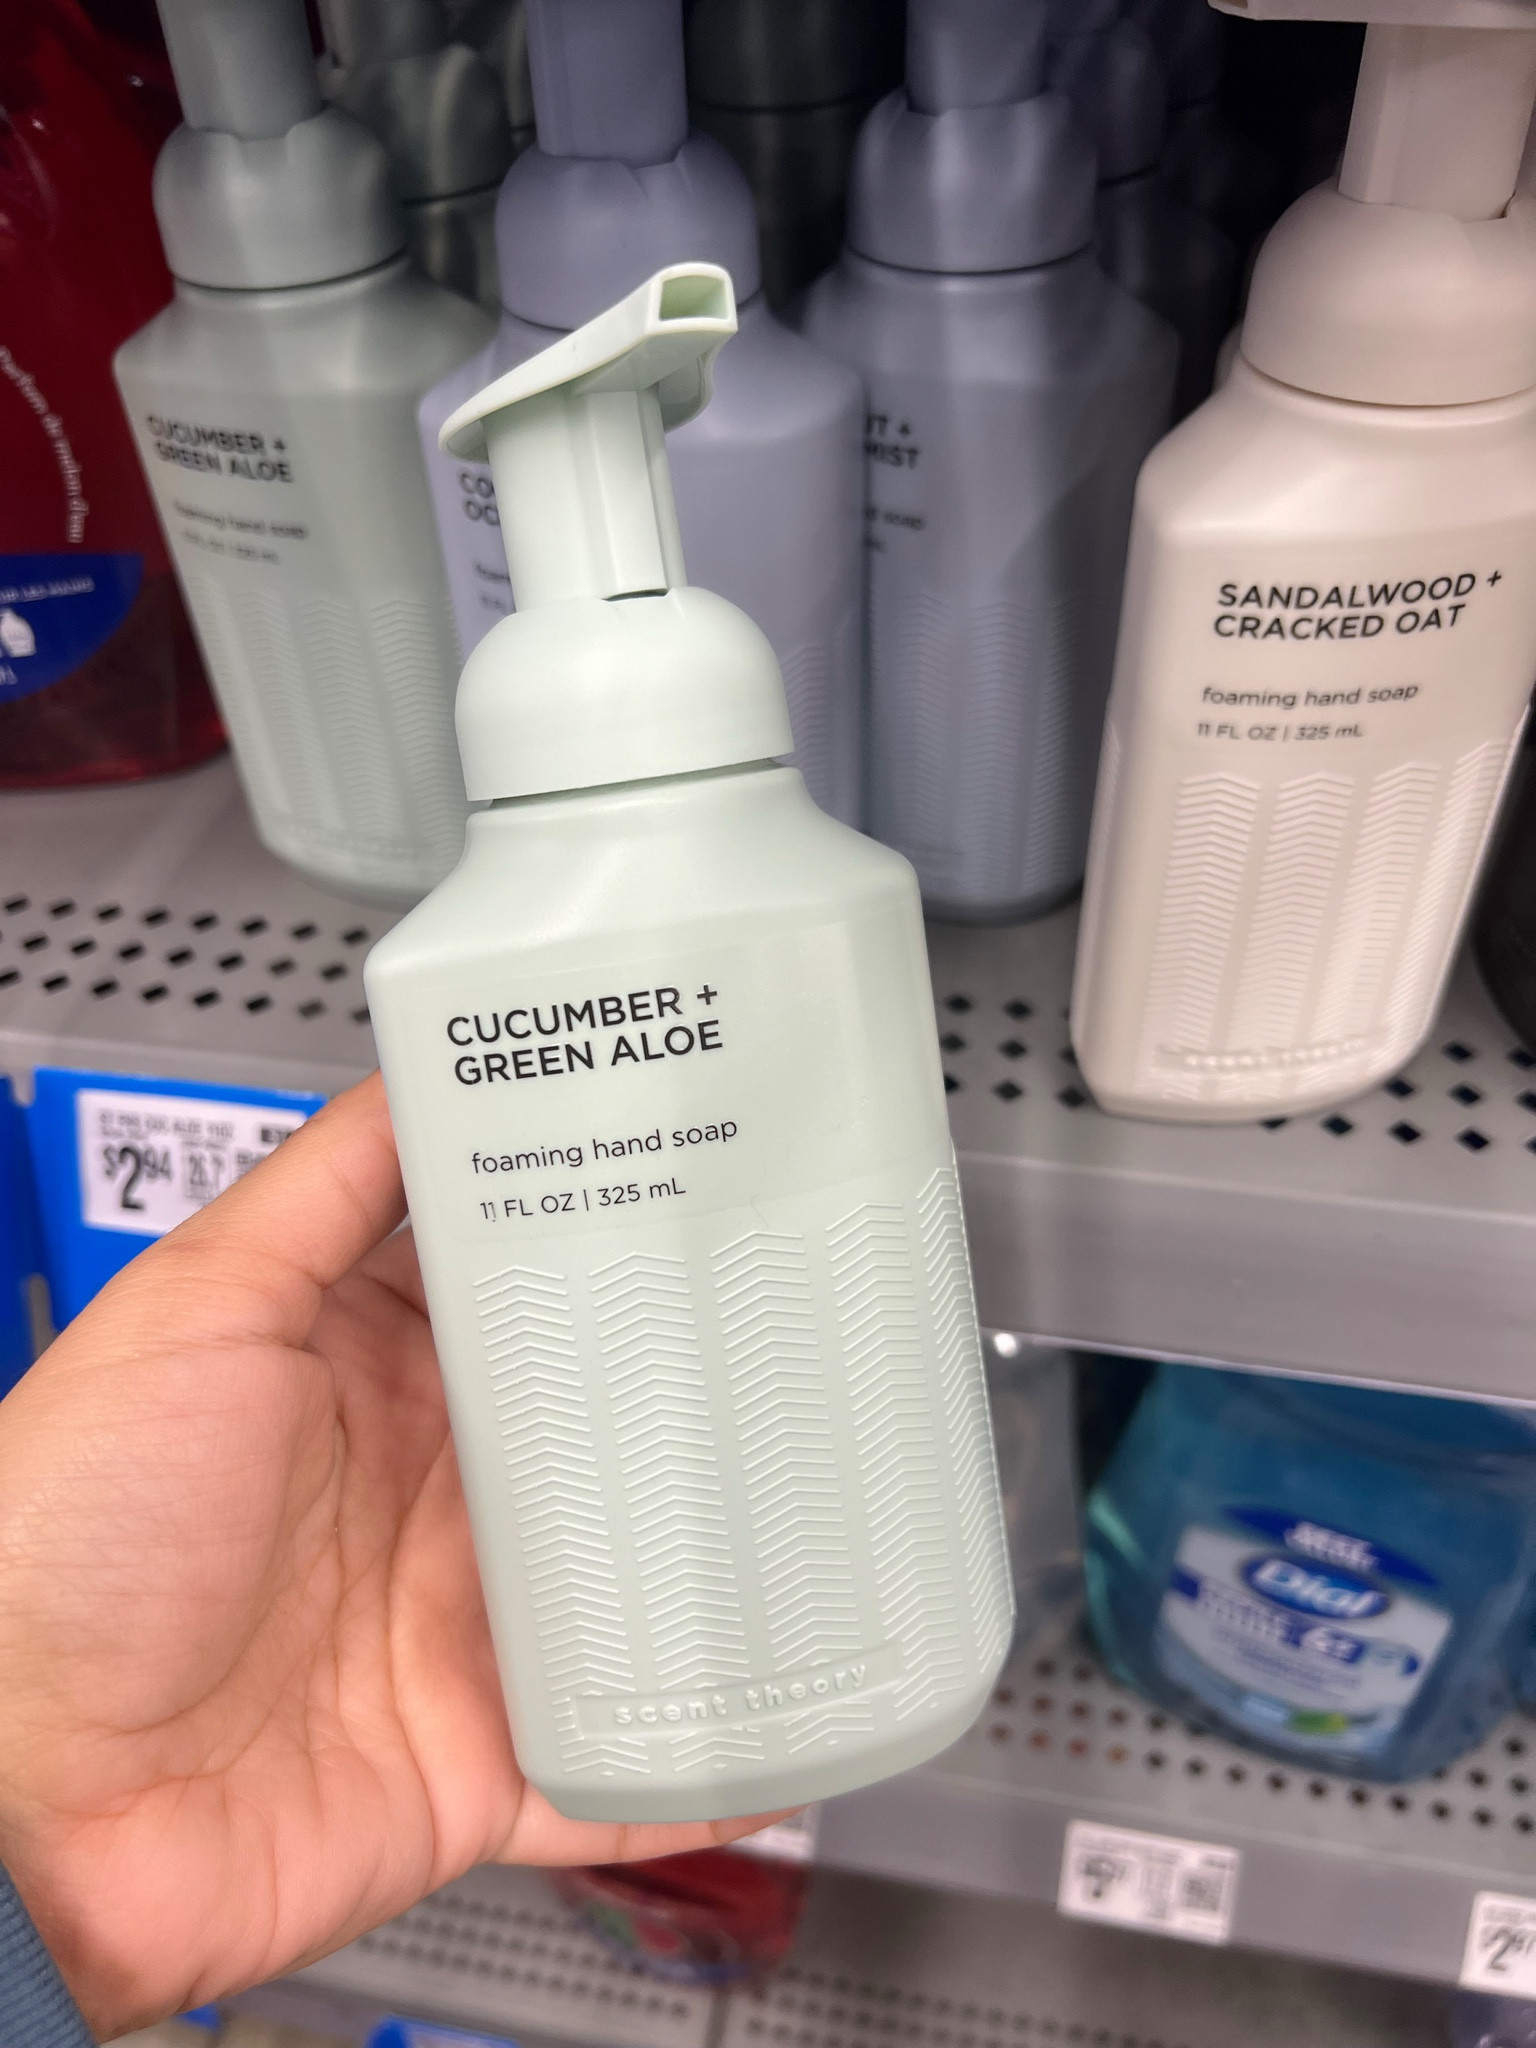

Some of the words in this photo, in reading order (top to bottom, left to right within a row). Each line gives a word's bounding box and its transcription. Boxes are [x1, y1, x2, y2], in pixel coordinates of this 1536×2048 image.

[148, 414, 267, 455] CUCUMBER
[155, 442, 222, 474] GREEN
[229, 455, 294, 483] ALOE
[1217, 572, 1477, 610] SANDALWOOD
[1486, 569, 1503, 588] +
[1212, 613, 1385, 640] CRACKED
[1394, 603, 1467, 635] OAT
[1201, 687, 1297, 710] foaming
[1304, 688, 1362, 706] hand
[1367, 684, 1419, 703] soap
[1216, 725, 1241, 740] FL
[1247, 725, 1277, 741] OZ
[1295, 725, 1329, 741] 325
[1334, 724, 1364, 738] mL
[446, 986, 684, 1046] CUCUMBER
[696, 983, 719, 1006] +
[453, 1040, 595, 1086] GREEN
[610, 1019, 724, 1067] ALOE
[472, 1145, 583, 1174] foaming
[592, 1128, 663, 1160] hand
[671, 1120, 738, 1148] soap
[479, 1201, 497, 1221] 11
[503, 1198, 534, 1218] FL
[540, 1192, 577, 1214] OZ
[596, 1183, 642, 1207] 325
[648, 1177, 687, 1199] mL
[611, 1694, 729, 1725] scent
[743, 1663, 867, 1711] theory
